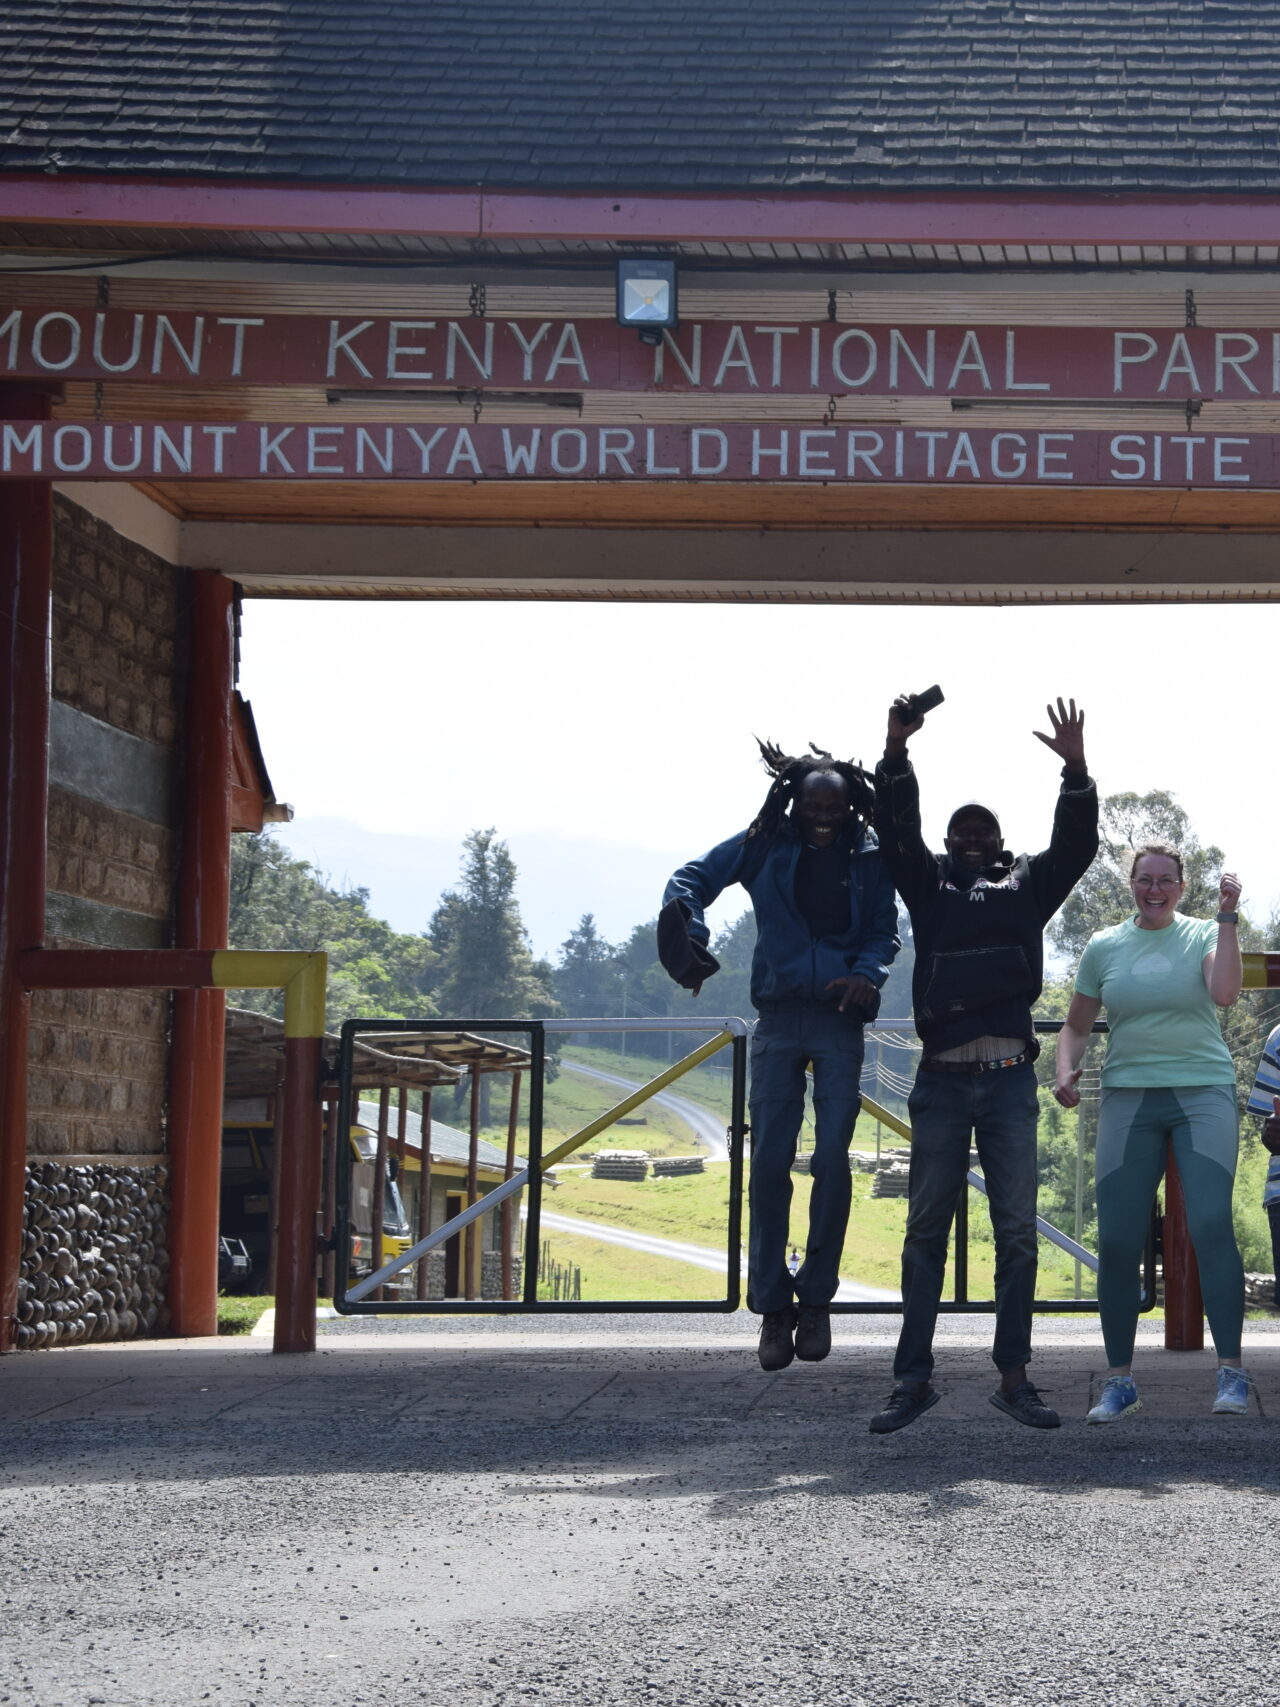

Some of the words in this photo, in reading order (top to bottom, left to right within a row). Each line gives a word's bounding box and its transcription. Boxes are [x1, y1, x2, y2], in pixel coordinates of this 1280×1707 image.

[326, 320, 590, 384] KENYA
[653, 323, 1051, 391] NATIONAL
[2, 424, 237, 474] MOUNT
[259, 426, 484, 476] KENYA
[501, 427, 728, 477] WORLD
[750, 429, 1075, 481] HERITAGE
[1110, 434, 1251, 483] SITE
